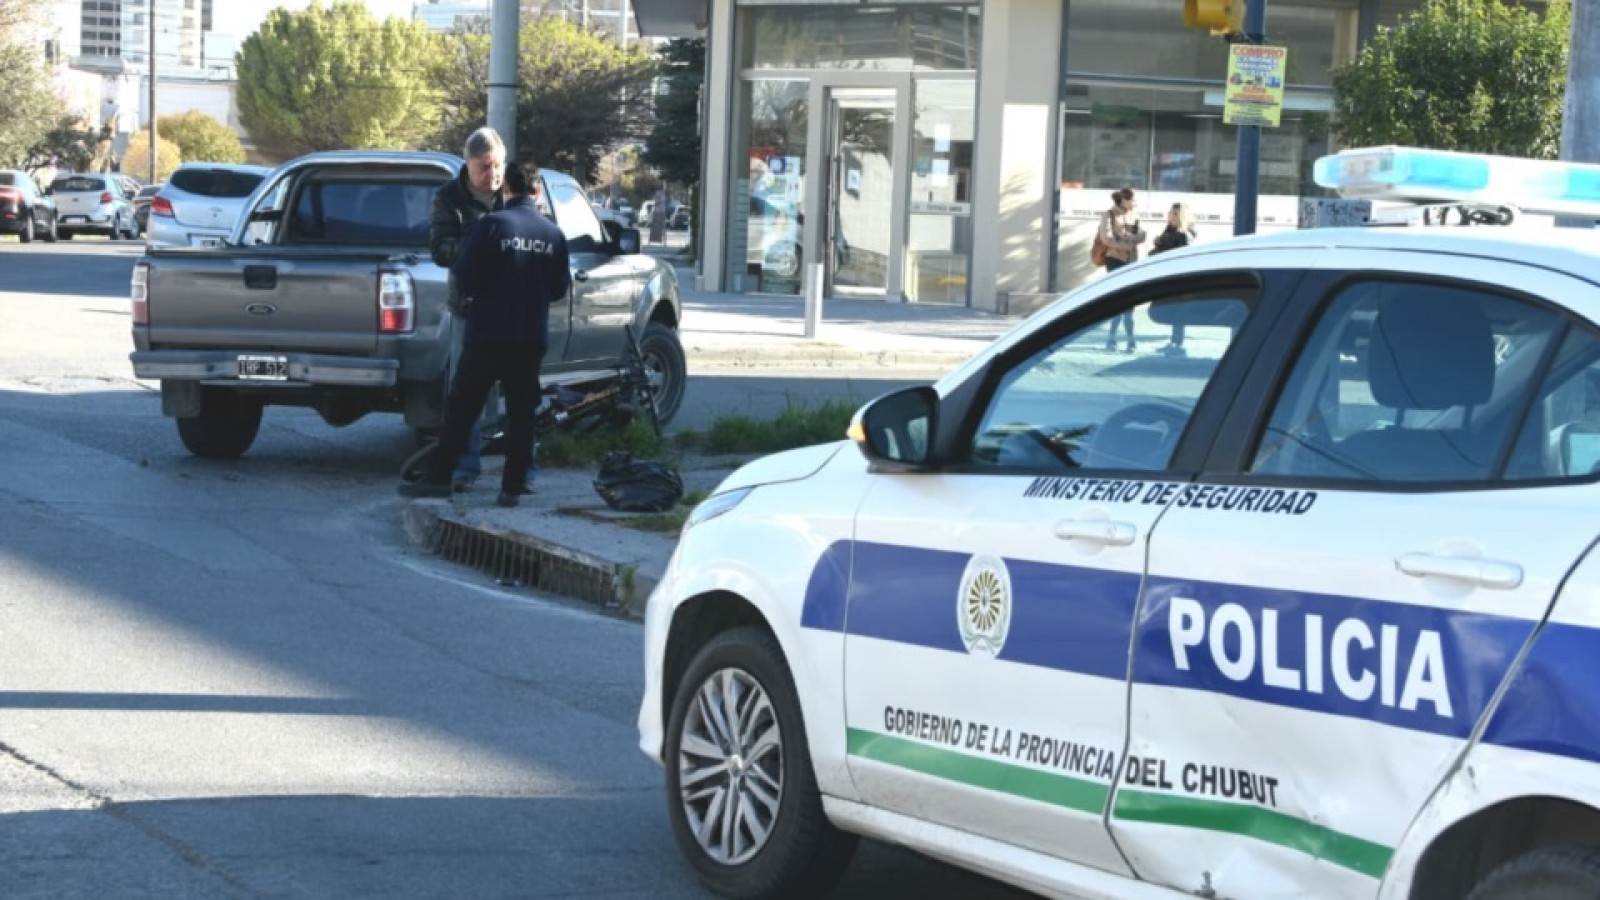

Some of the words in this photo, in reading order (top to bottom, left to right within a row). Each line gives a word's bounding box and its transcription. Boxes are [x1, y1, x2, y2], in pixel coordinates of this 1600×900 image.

[501, 236, 554, 256] POLICIA
[1023, 476, 1144, 503] MINISTERIO
[1141, 482, 1178, 505] DE
[1177, 484, 1318, 515] SEGURIDAD
[1168, 596, 1454, 718] POLICIA
[884, 705, 962, 746] GOBIERNO
[965, 722, 990, 751] DE
[991, 725, 1011, 757] LA
[1015, 732, 1114, 779] PROVINCIA
[1125, 756, 1173, 789] DEL
[1182, 762, 1279, 808] CHUBUT
